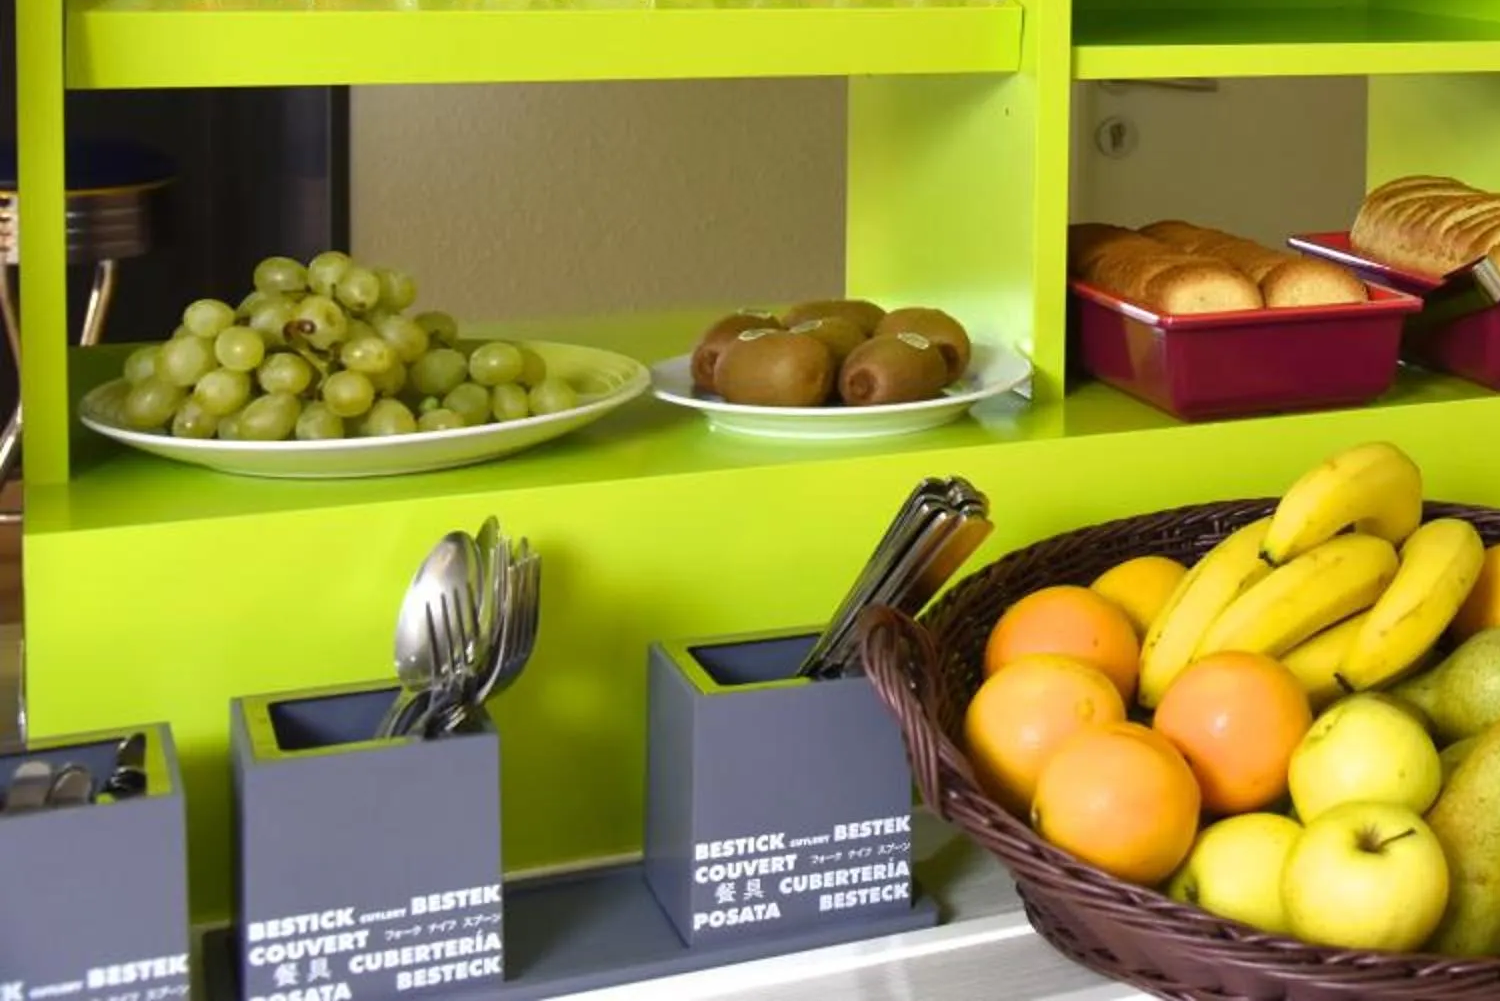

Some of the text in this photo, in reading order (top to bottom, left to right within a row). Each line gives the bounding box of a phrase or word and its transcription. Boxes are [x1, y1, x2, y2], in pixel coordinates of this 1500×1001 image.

[695, 832, 786, 861] BESTICK
[834, 815, 911, 842] BESTEK
[695, 854, 797, 884] COUVERT
[779, 857, 910, 895] CUBERTERÍA
[248, 907, 355, 942] BESTICK
[411, 884, 502, 916] BESTEK
[819, 882, 910, 912] BESTECK
[693, 902, 781, 931] POSATA
[249, 930, 369, 966] COUVERT
[348, 929, 502, 974] CUBERTERÍA
[87, 953, 190, 990] BESTEK
[396, 956, 502, 991] BESTECK
